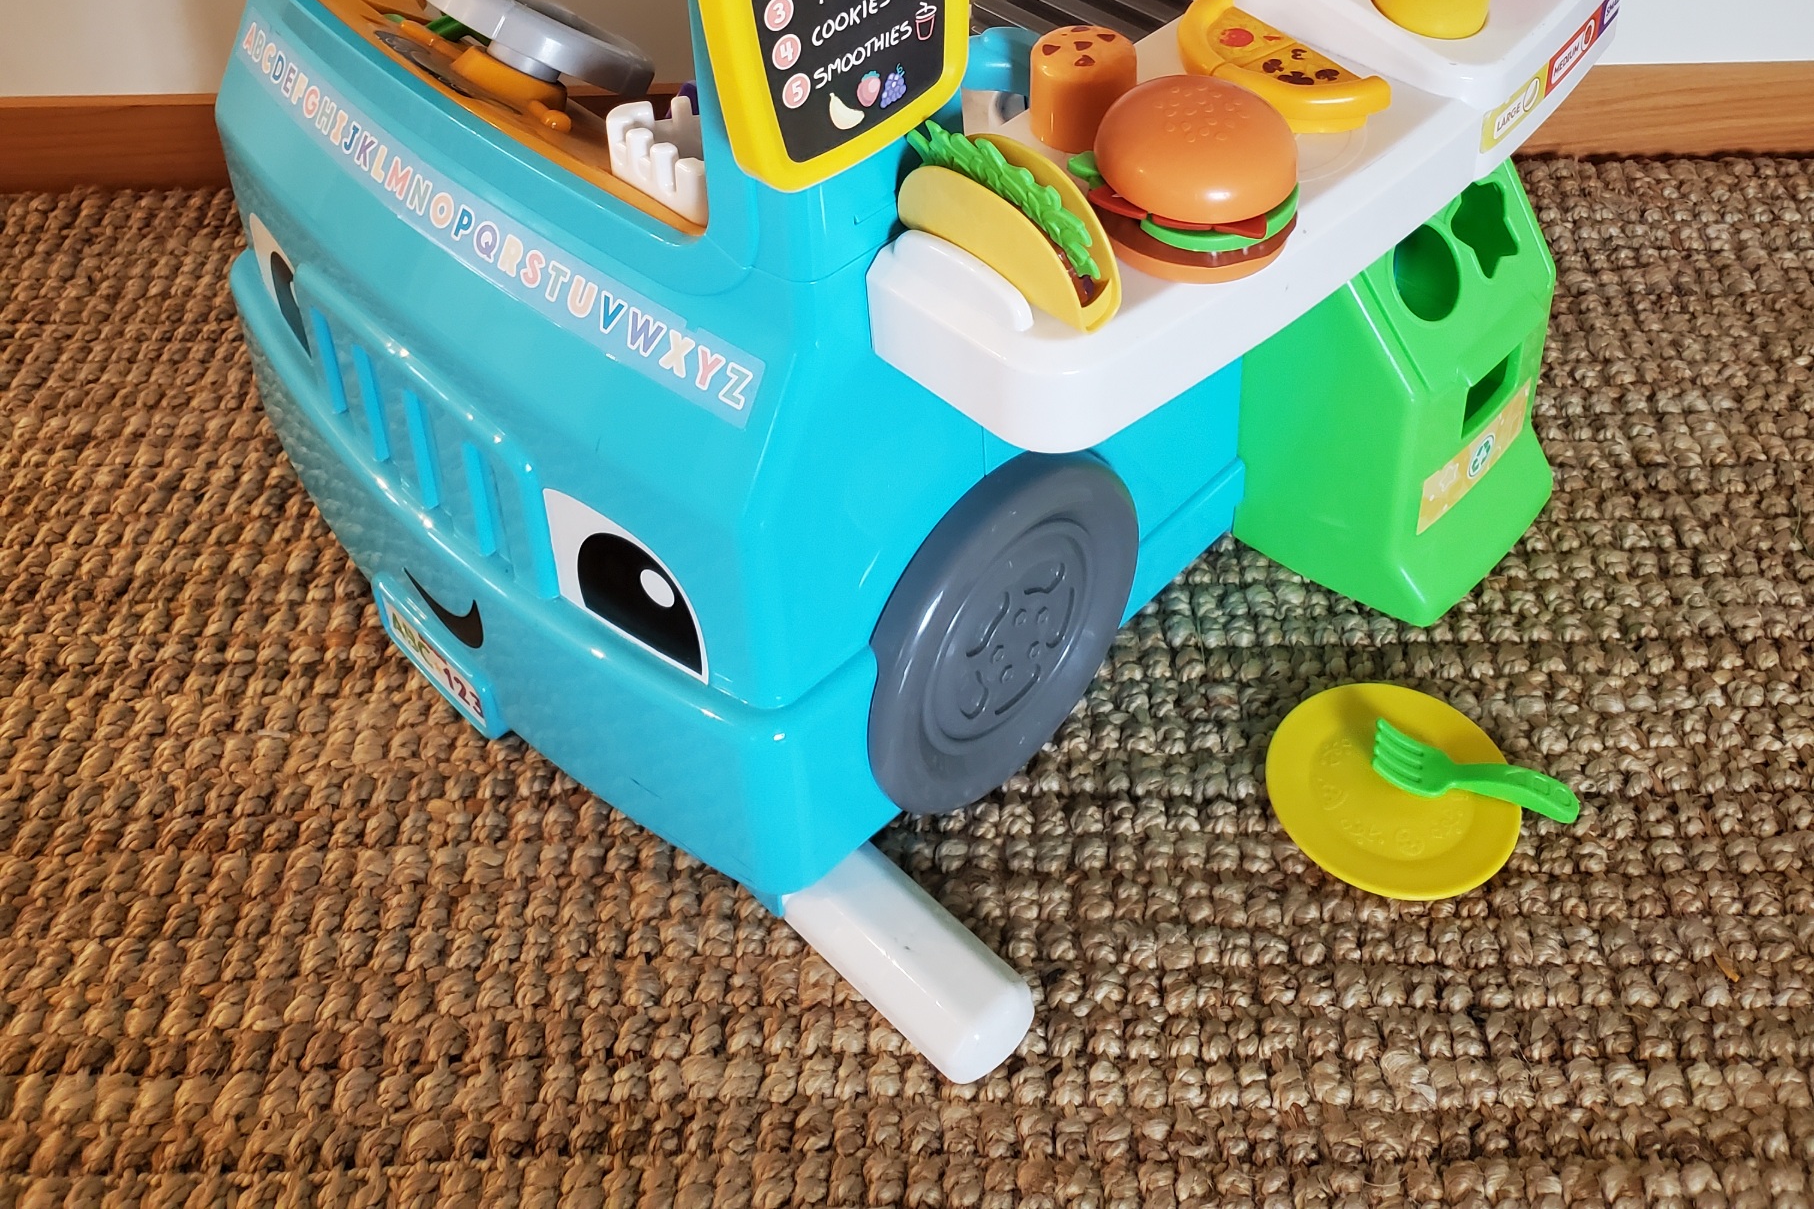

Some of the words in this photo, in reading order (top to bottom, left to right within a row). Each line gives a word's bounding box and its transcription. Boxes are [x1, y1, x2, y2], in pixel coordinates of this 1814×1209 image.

[771, 2, 786, 24] 3
[779, 41, 794, 62] 4
[813, 20, 913, 90] SMOOTHIES
[1553, 42, 1580, 77] MEDIUM
[791, 81, 804, 103] 5
[1496, 102, 1521, 132] LARGE
[443, 668, 484, 719] 123
